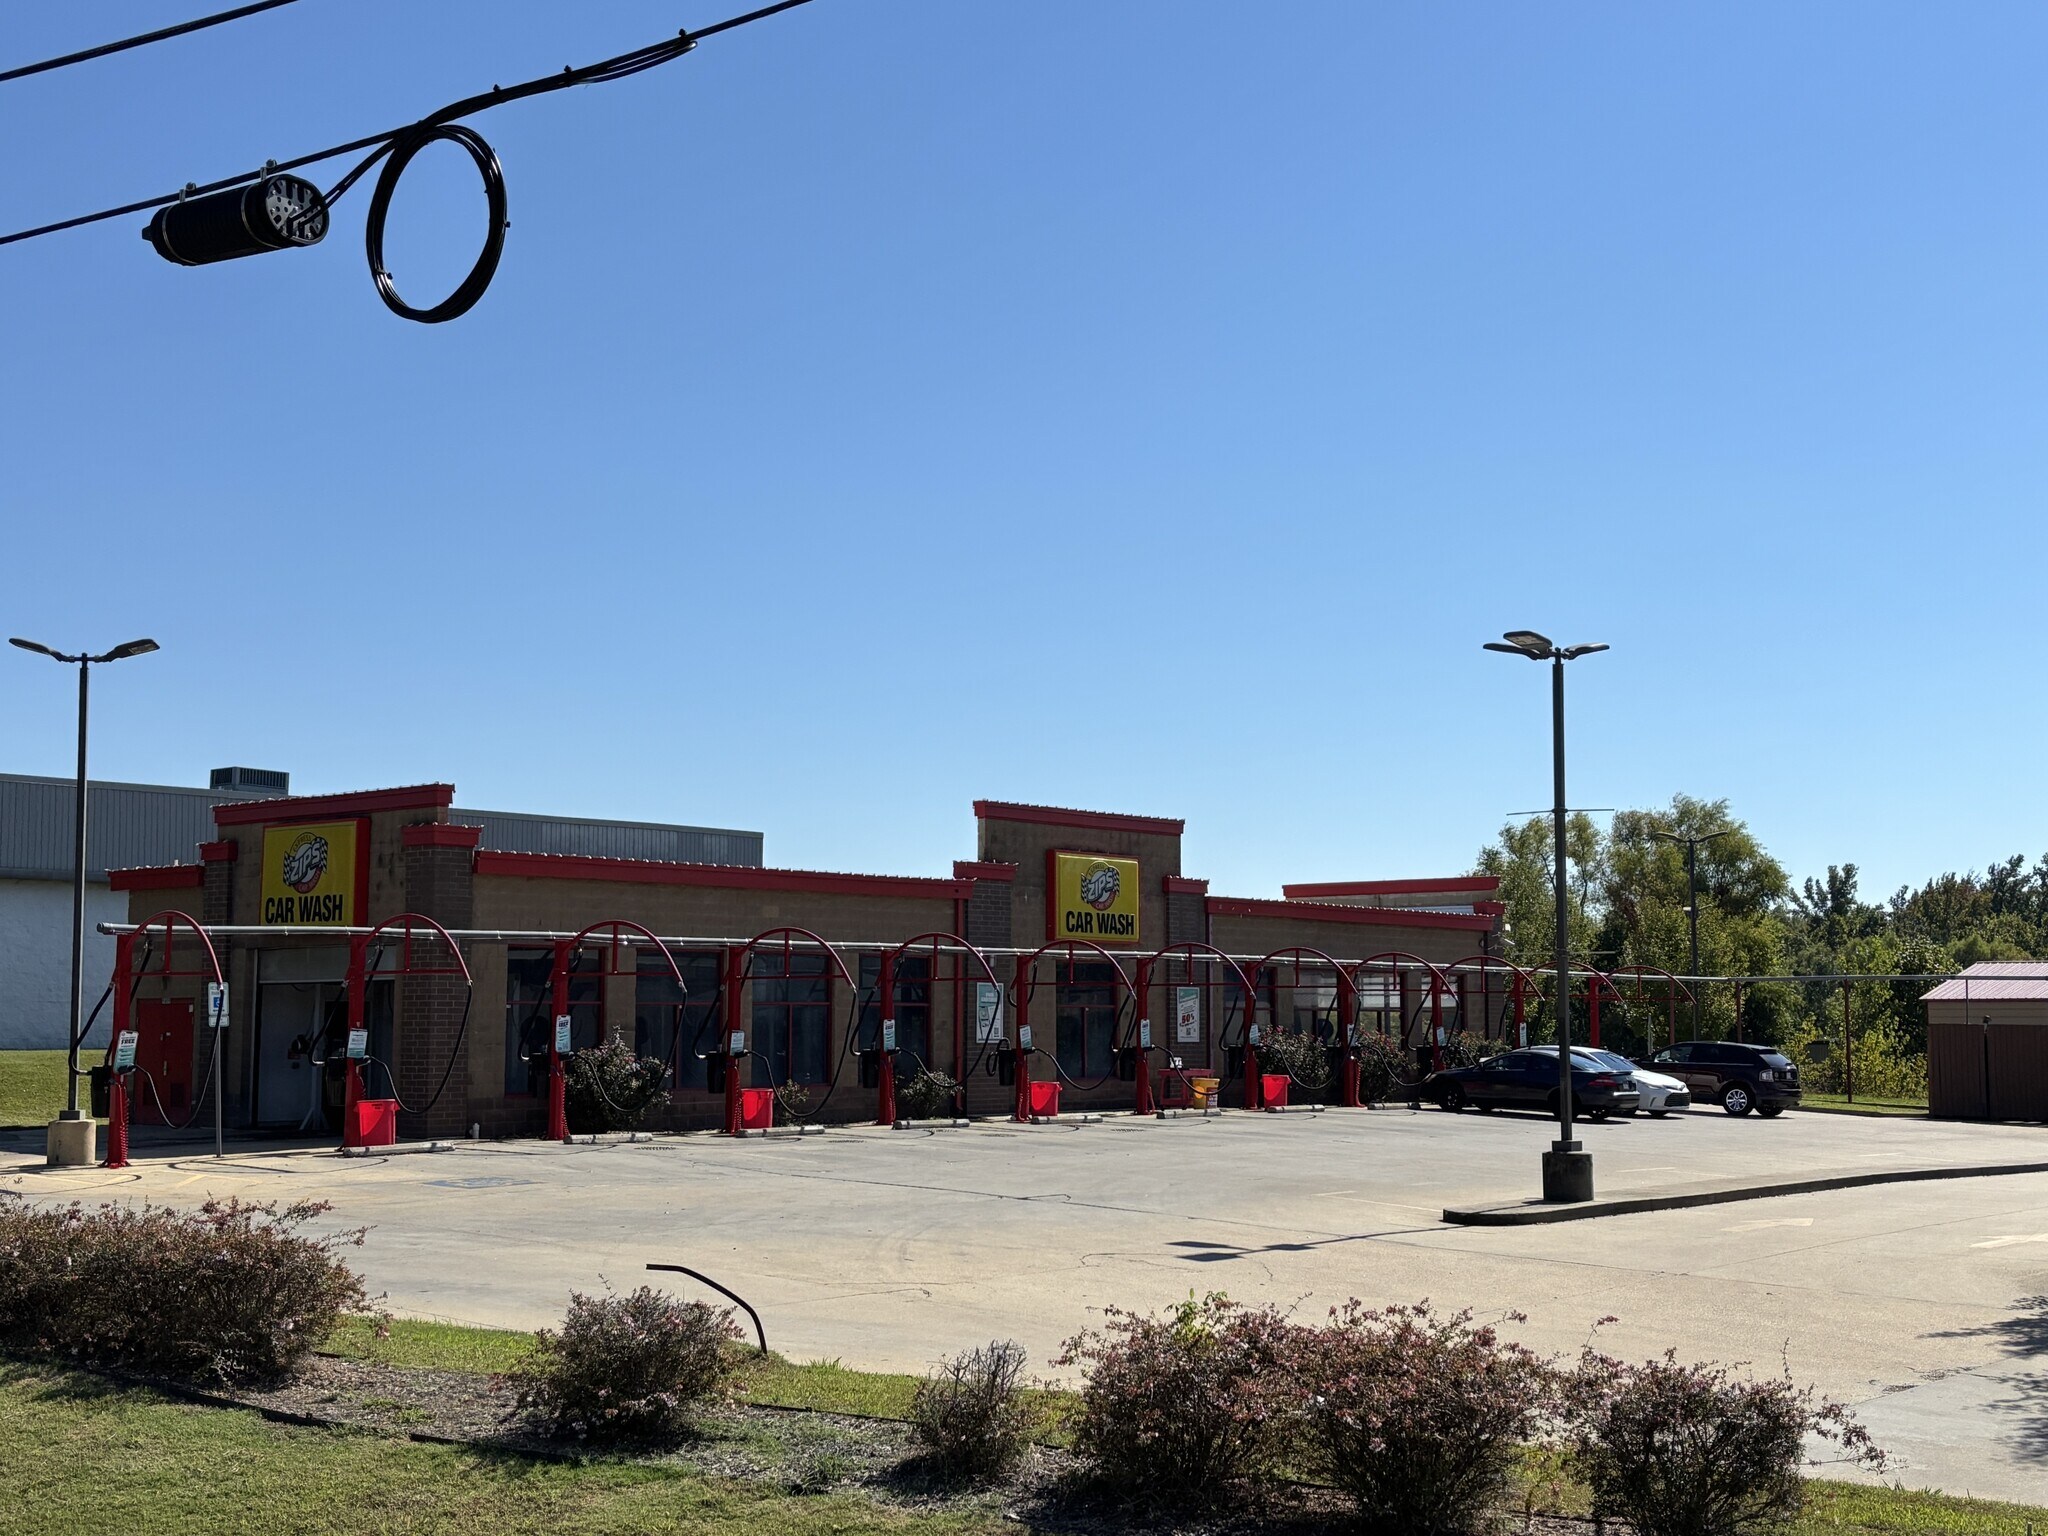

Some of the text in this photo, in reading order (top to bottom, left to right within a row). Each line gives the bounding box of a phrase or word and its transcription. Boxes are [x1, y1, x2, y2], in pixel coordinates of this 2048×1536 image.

[289, 841, 320, 881] ZIPS
[1087, 871, 1114, 900] ZIPS
[265, 894, 343, 924] CAR WASH
[1066, 910, 1135, 936] CAR WASH
